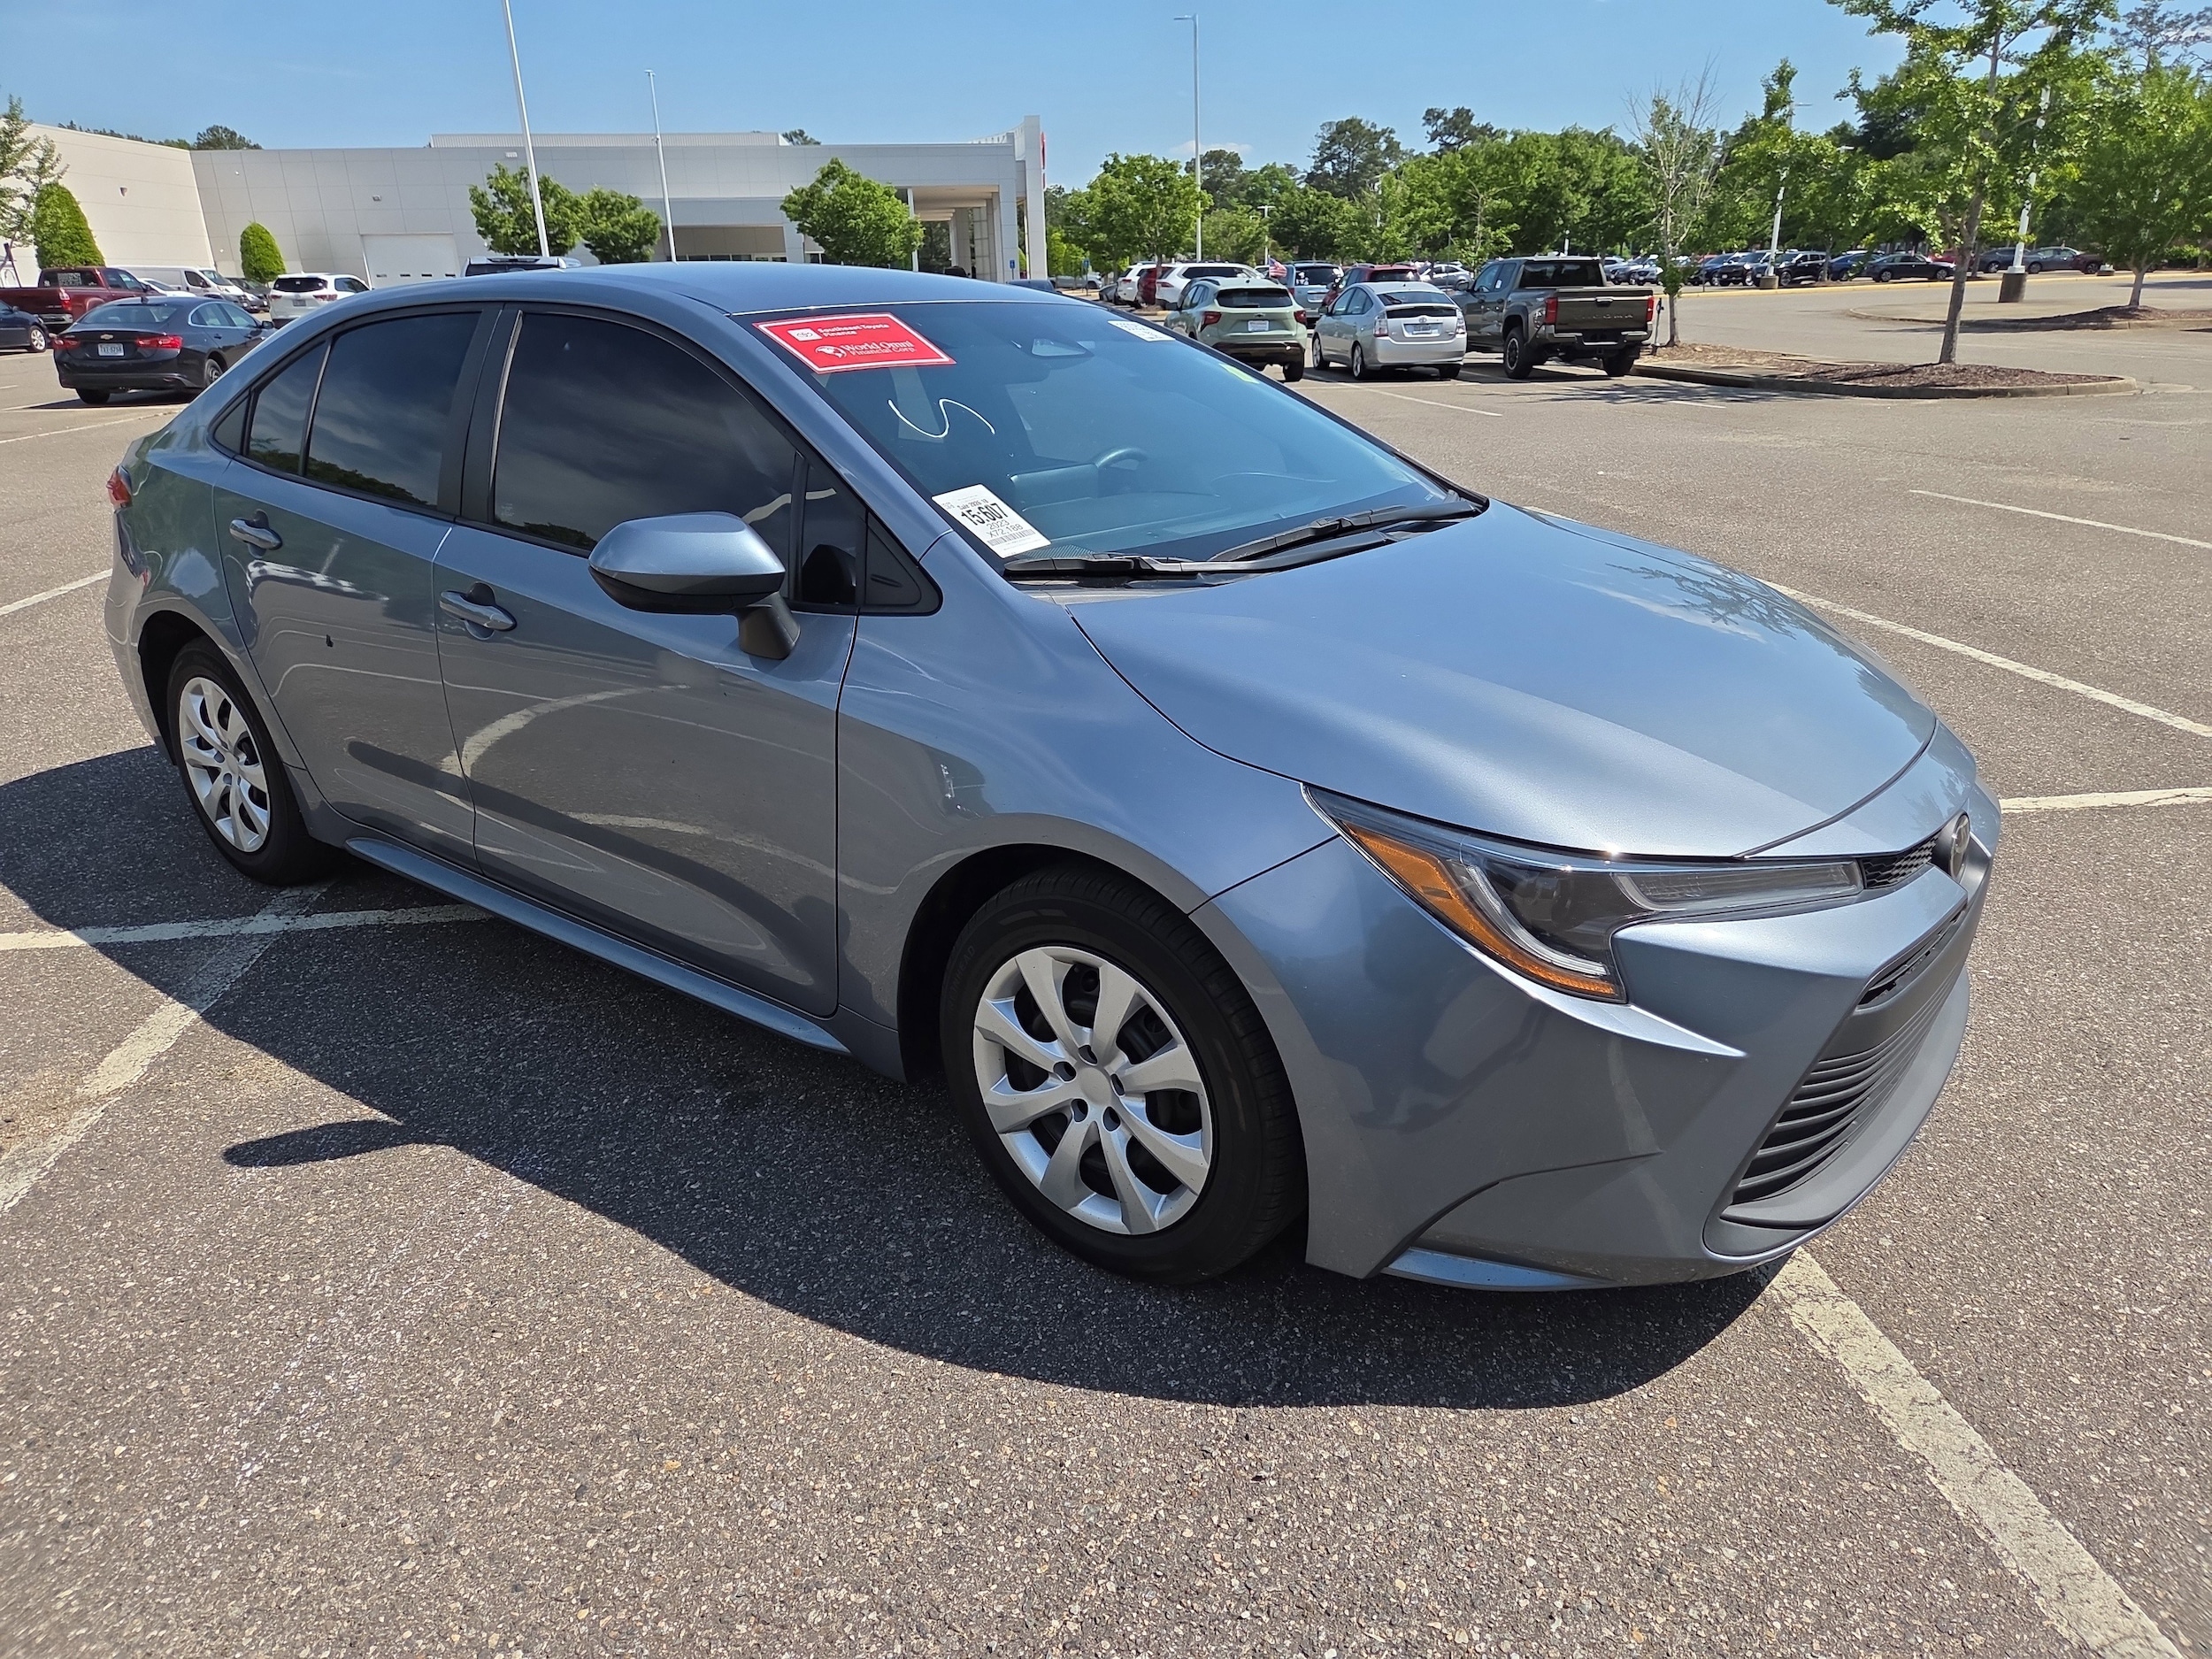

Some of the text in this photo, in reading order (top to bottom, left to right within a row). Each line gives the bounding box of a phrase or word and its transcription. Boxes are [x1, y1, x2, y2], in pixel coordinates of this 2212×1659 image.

[840, 340, 914, 351] World Omni
[987, 519, 1010, 531] 2023
